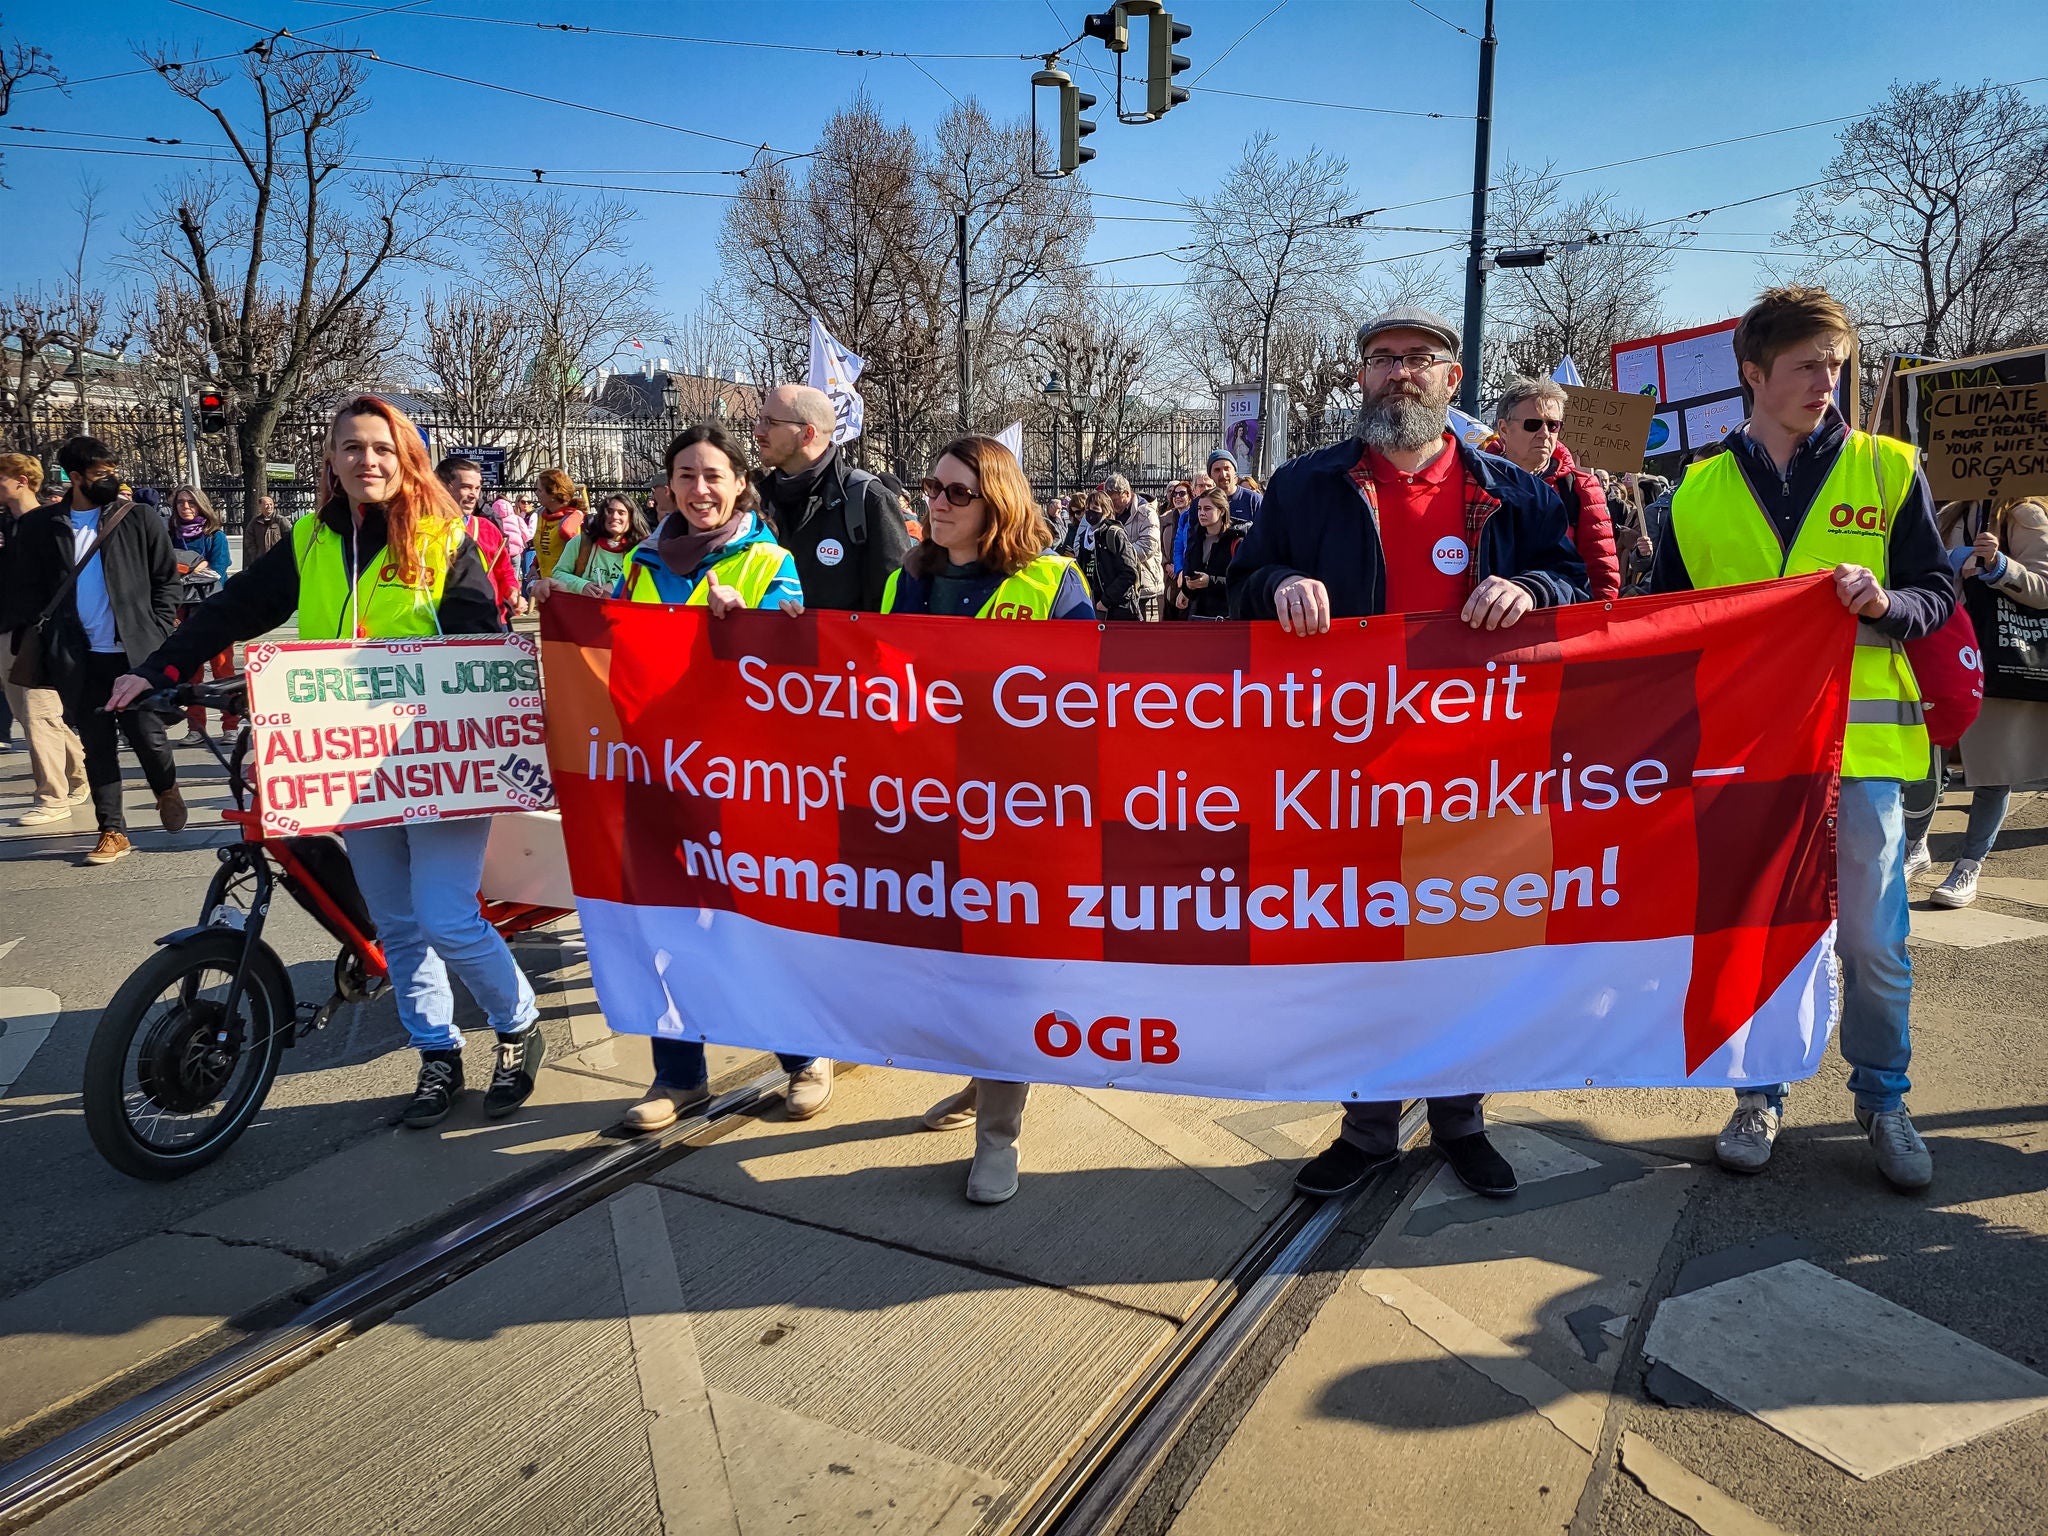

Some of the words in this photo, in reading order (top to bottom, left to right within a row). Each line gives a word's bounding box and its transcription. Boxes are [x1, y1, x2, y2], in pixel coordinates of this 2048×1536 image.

[1231, 401, 1250, 412] SISI
[1603, 401, 1628, 416] IST
[1934, 389, 2038, 417] CLIMATE
[1565, 415, 1594, 428] TTER
[1601, 423, 1622, 433] ALS
[1974, 410, 2047, 427] CHANGE
[1593, 435, 1631, 452] DEINER
[1933, 429, 1945, 440] IS
[1951, 427, 1988, 439] MORE
[1991, 425, 2029, 437] REAL
[1945, 440, 1984, 455] YOUR
[286, 663, 426, 703] GREEN
[441, 659, 539, 694] JOBS
[738, 655, 963, 724] Soziale
[993, 661, 1526, 743] Gerechtigkeit
[264, 713, 546, 765] AUSBILDUNGS
[267, 760, 498, 810] OFFENSIVE
[588, 726, 651, 785] im
[664, 738, 847, 821] Kampf
[869, 774, 1092, 841] gegen
[1124, 769, 1240, 832] die
[1275, 752, 1668, 830] Klimakrise
[682, 830, 1040, 925] niemanden
[1067, 845, 1620, 931] zurücklassen!
